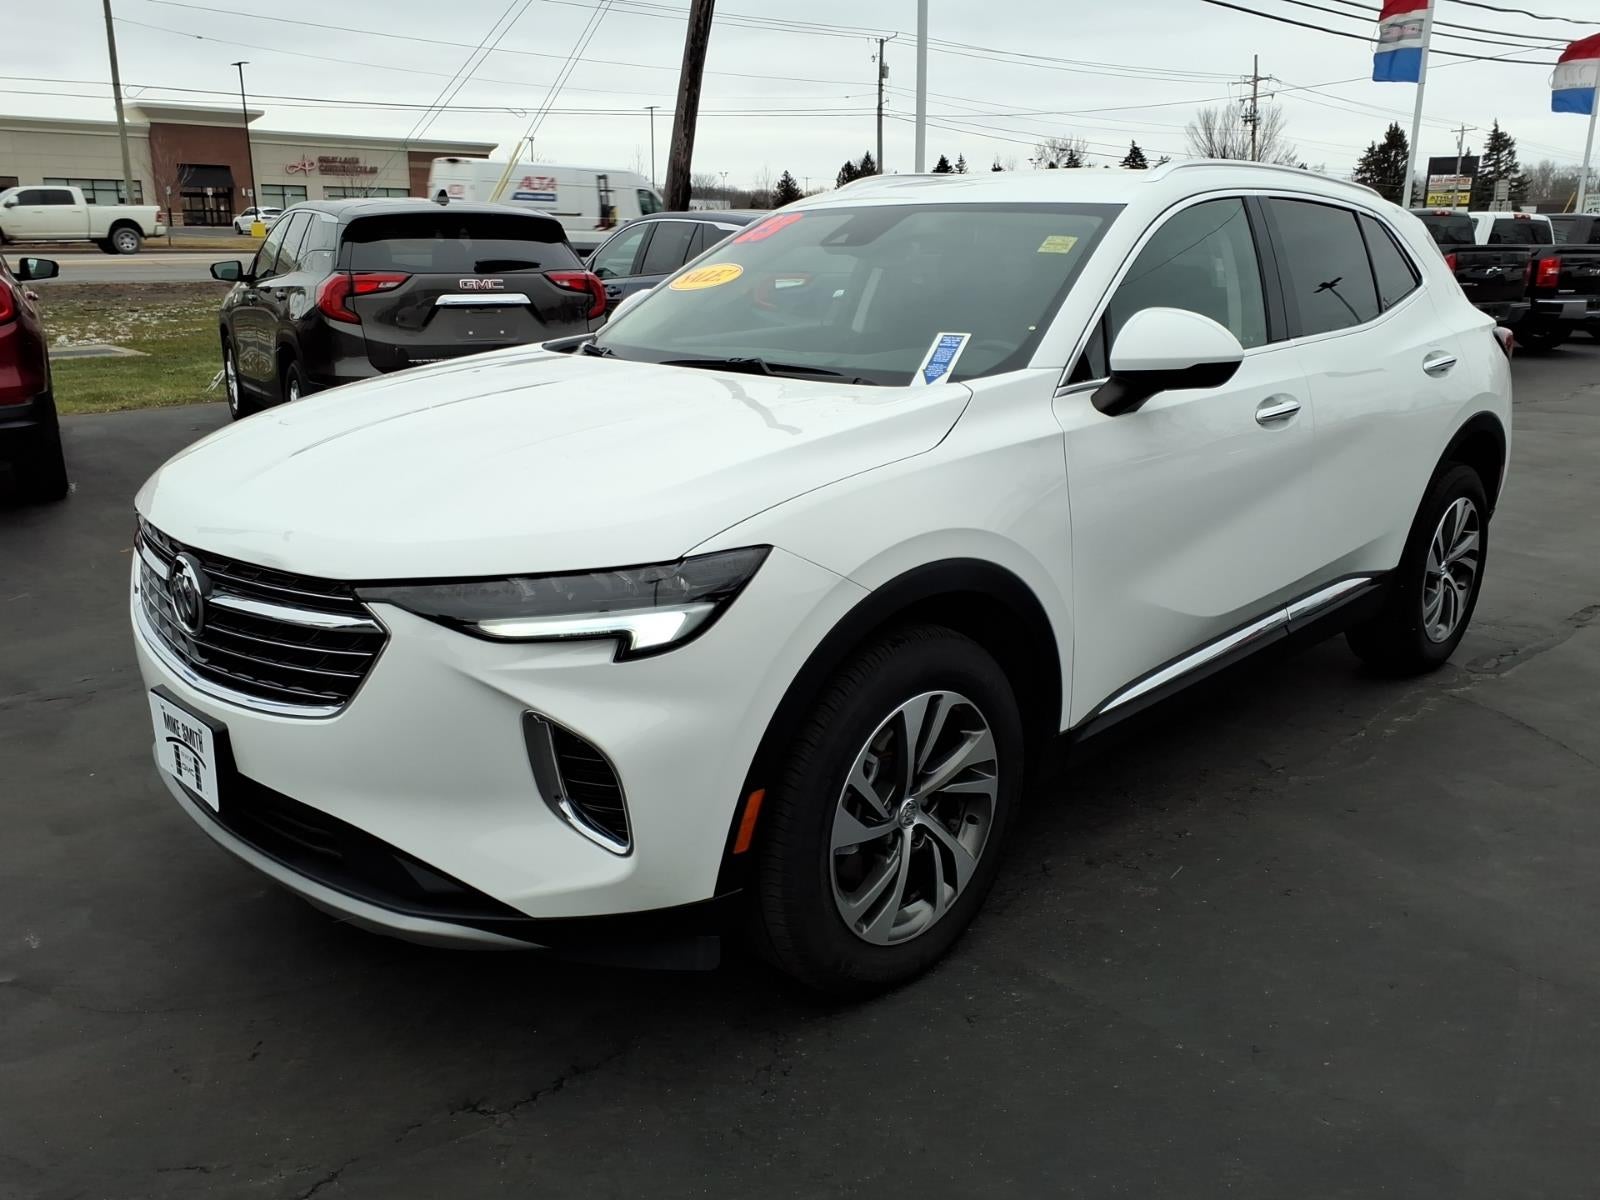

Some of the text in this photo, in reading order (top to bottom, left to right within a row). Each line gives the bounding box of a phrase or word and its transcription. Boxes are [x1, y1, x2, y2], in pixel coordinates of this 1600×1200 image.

[518, 175, 558, 191] ALTA
[459, 279, 505, 290] GMC
[162, 711, 204, 754] MIKE SMITH
